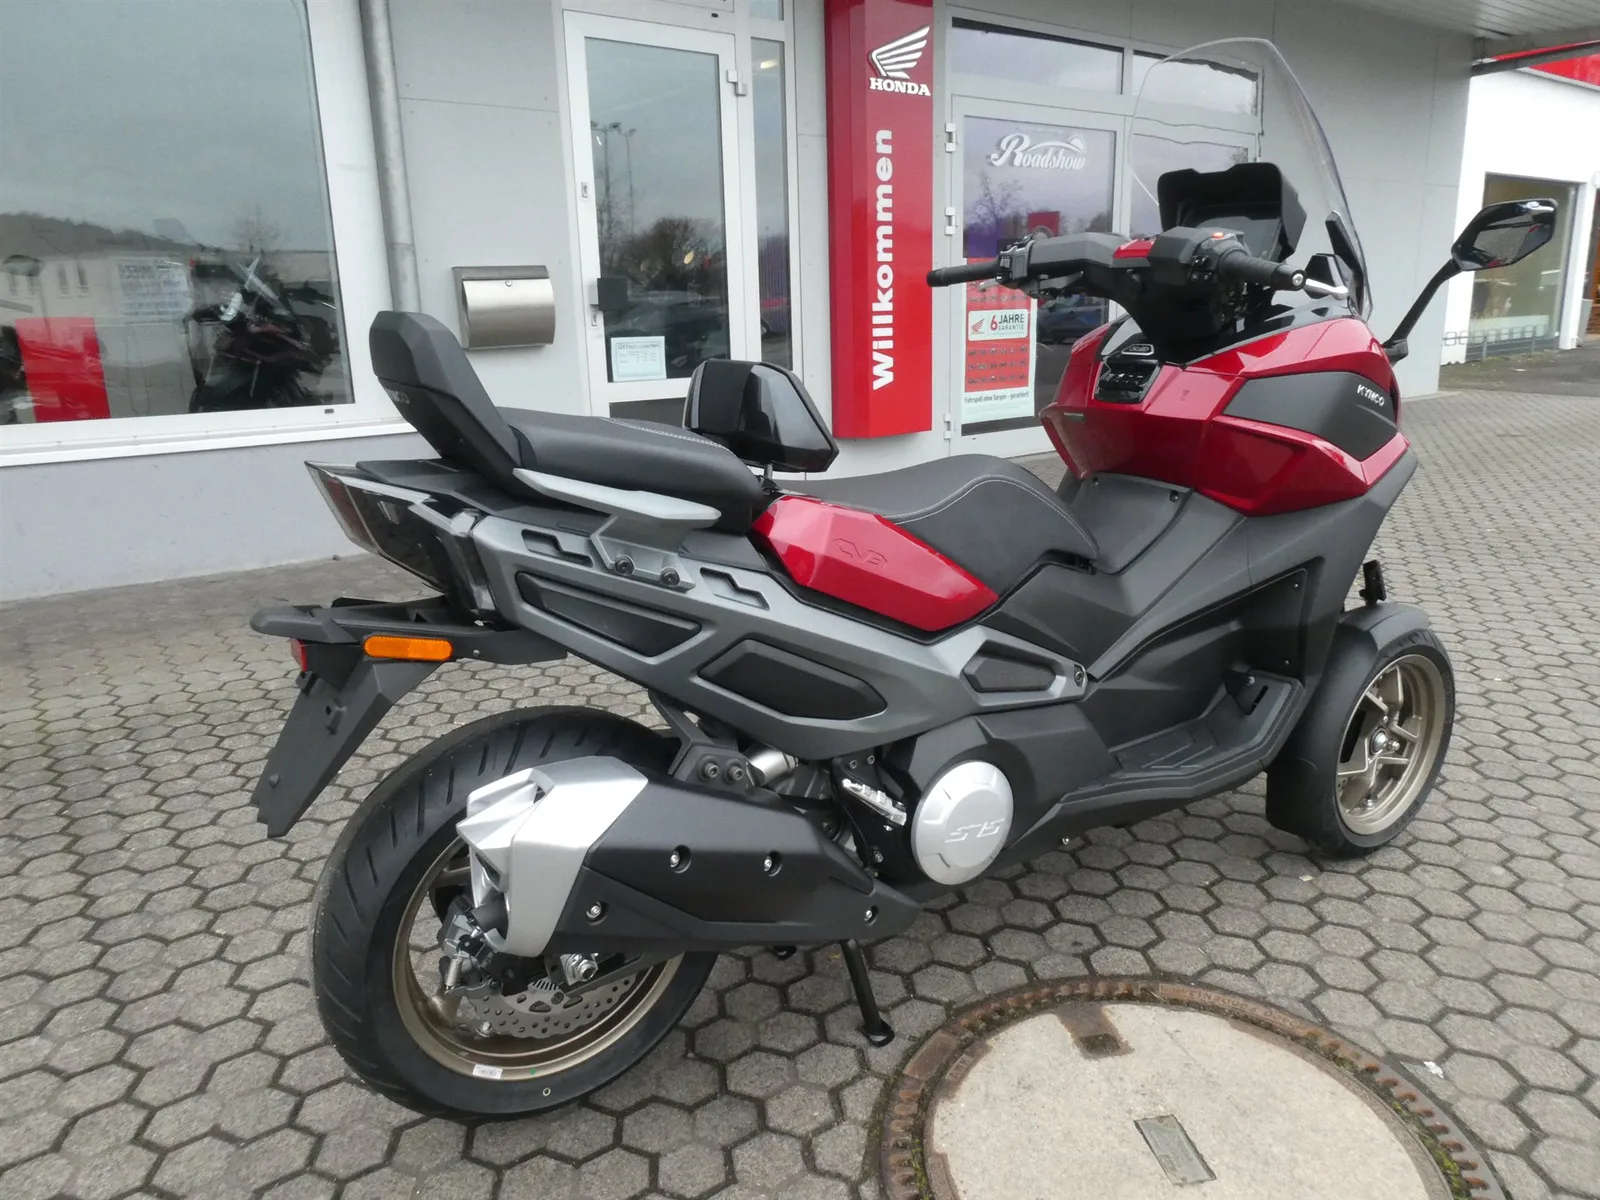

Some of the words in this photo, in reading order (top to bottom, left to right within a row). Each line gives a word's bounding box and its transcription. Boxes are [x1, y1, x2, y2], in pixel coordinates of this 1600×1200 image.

[869, 77, 931, 96] HONDA
[990, 133, 1086, 170] Roadshow
[872, 129, 894, 391] Willkommen
[990, 314, 998, 331] 6
[998, 313, 1025, 324] JAHRE
